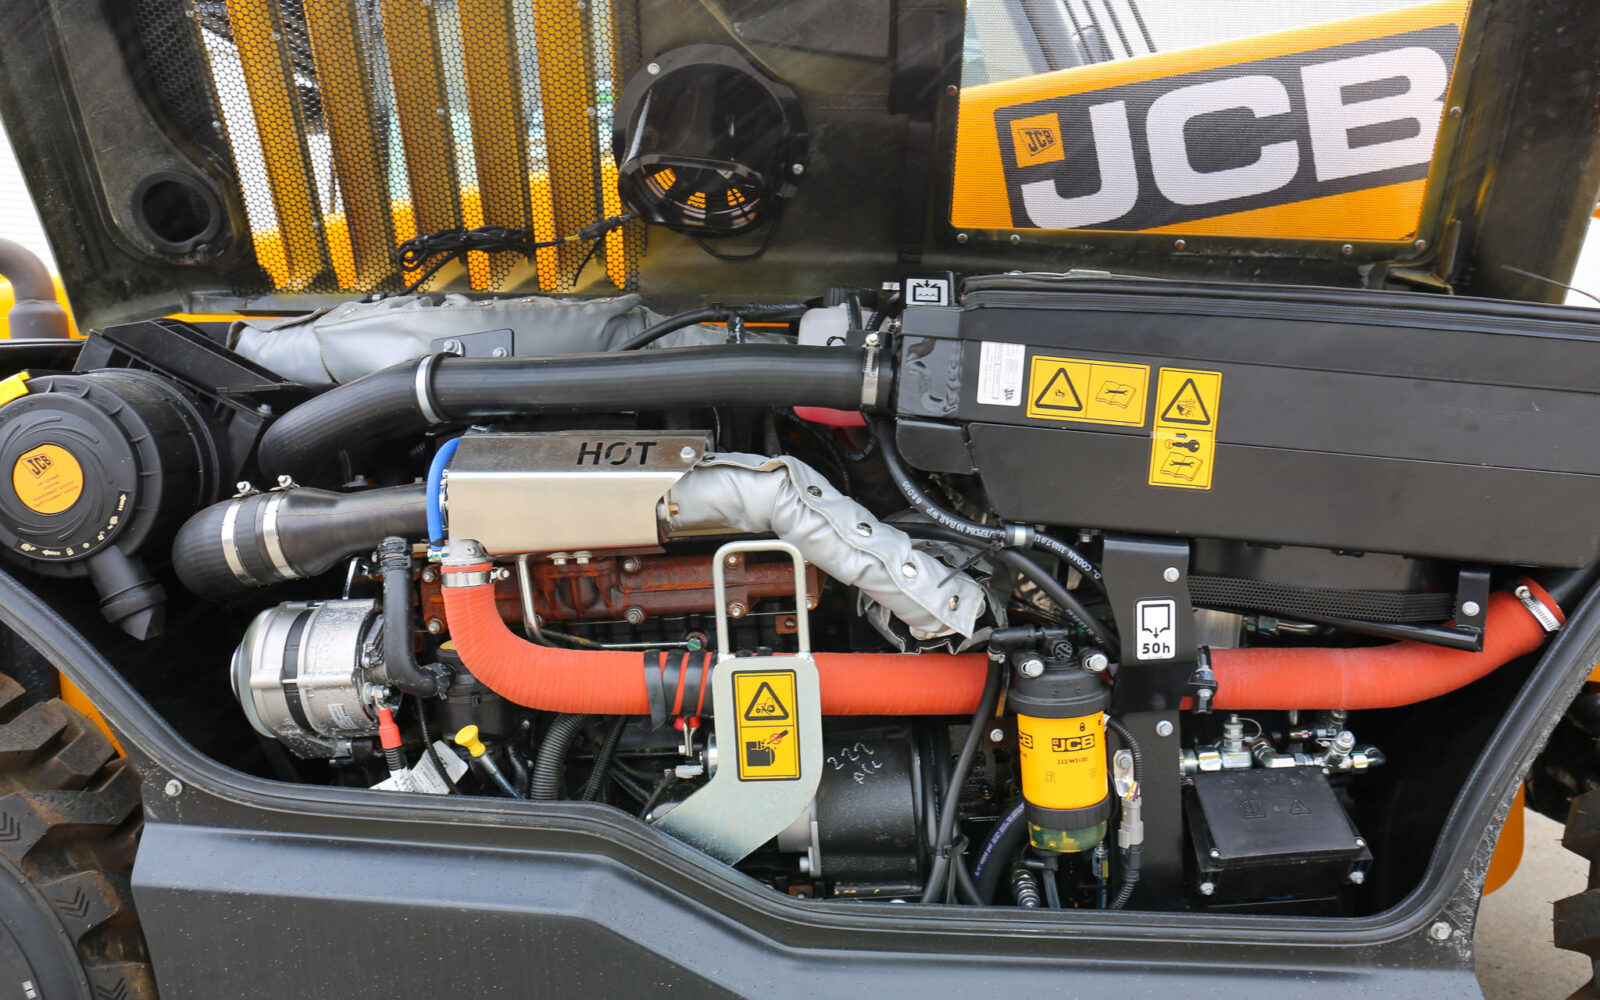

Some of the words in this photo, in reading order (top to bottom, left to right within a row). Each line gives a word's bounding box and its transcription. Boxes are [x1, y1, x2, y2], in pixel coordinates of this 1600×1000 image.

[1020, 46, 1448, 230] JCB
[1025, 130, 1055, 152] JCB
[576, 441, 657, 466] HOT
[27, 455, 52, 476] JCB
[1067, 550, 1092, 571] CODAN
[1053, 734, 1095, 752] JCB
[826, 742, 875, 770] 222
